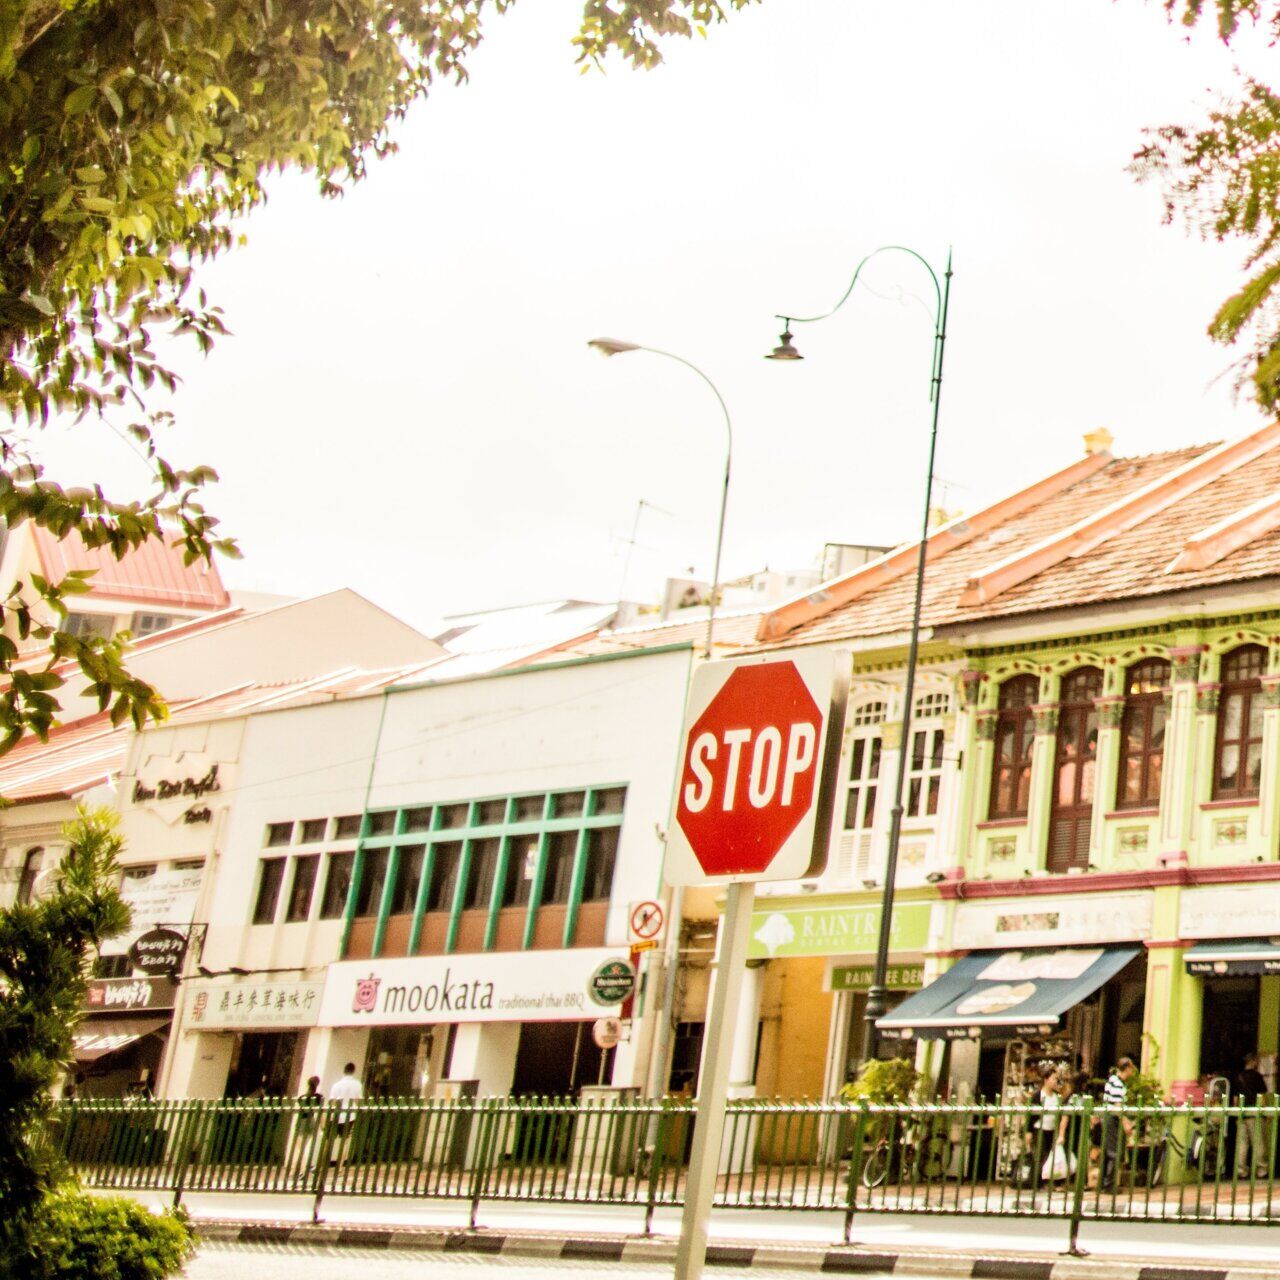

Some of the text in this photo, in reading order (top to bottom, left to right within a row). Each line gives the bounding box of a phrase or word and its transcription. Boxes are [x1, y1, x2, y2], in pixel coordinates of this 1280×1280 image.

[684, 722, 816, 813] STOP
[803, 910, 901, 938] RAINTRE
[383, 968, 495, 1013] mookata
[499, 992, 544, 1009] traditional
[563, 992, 584, 1011] BBQ
[845, 971, 898, 984] RAINEE
